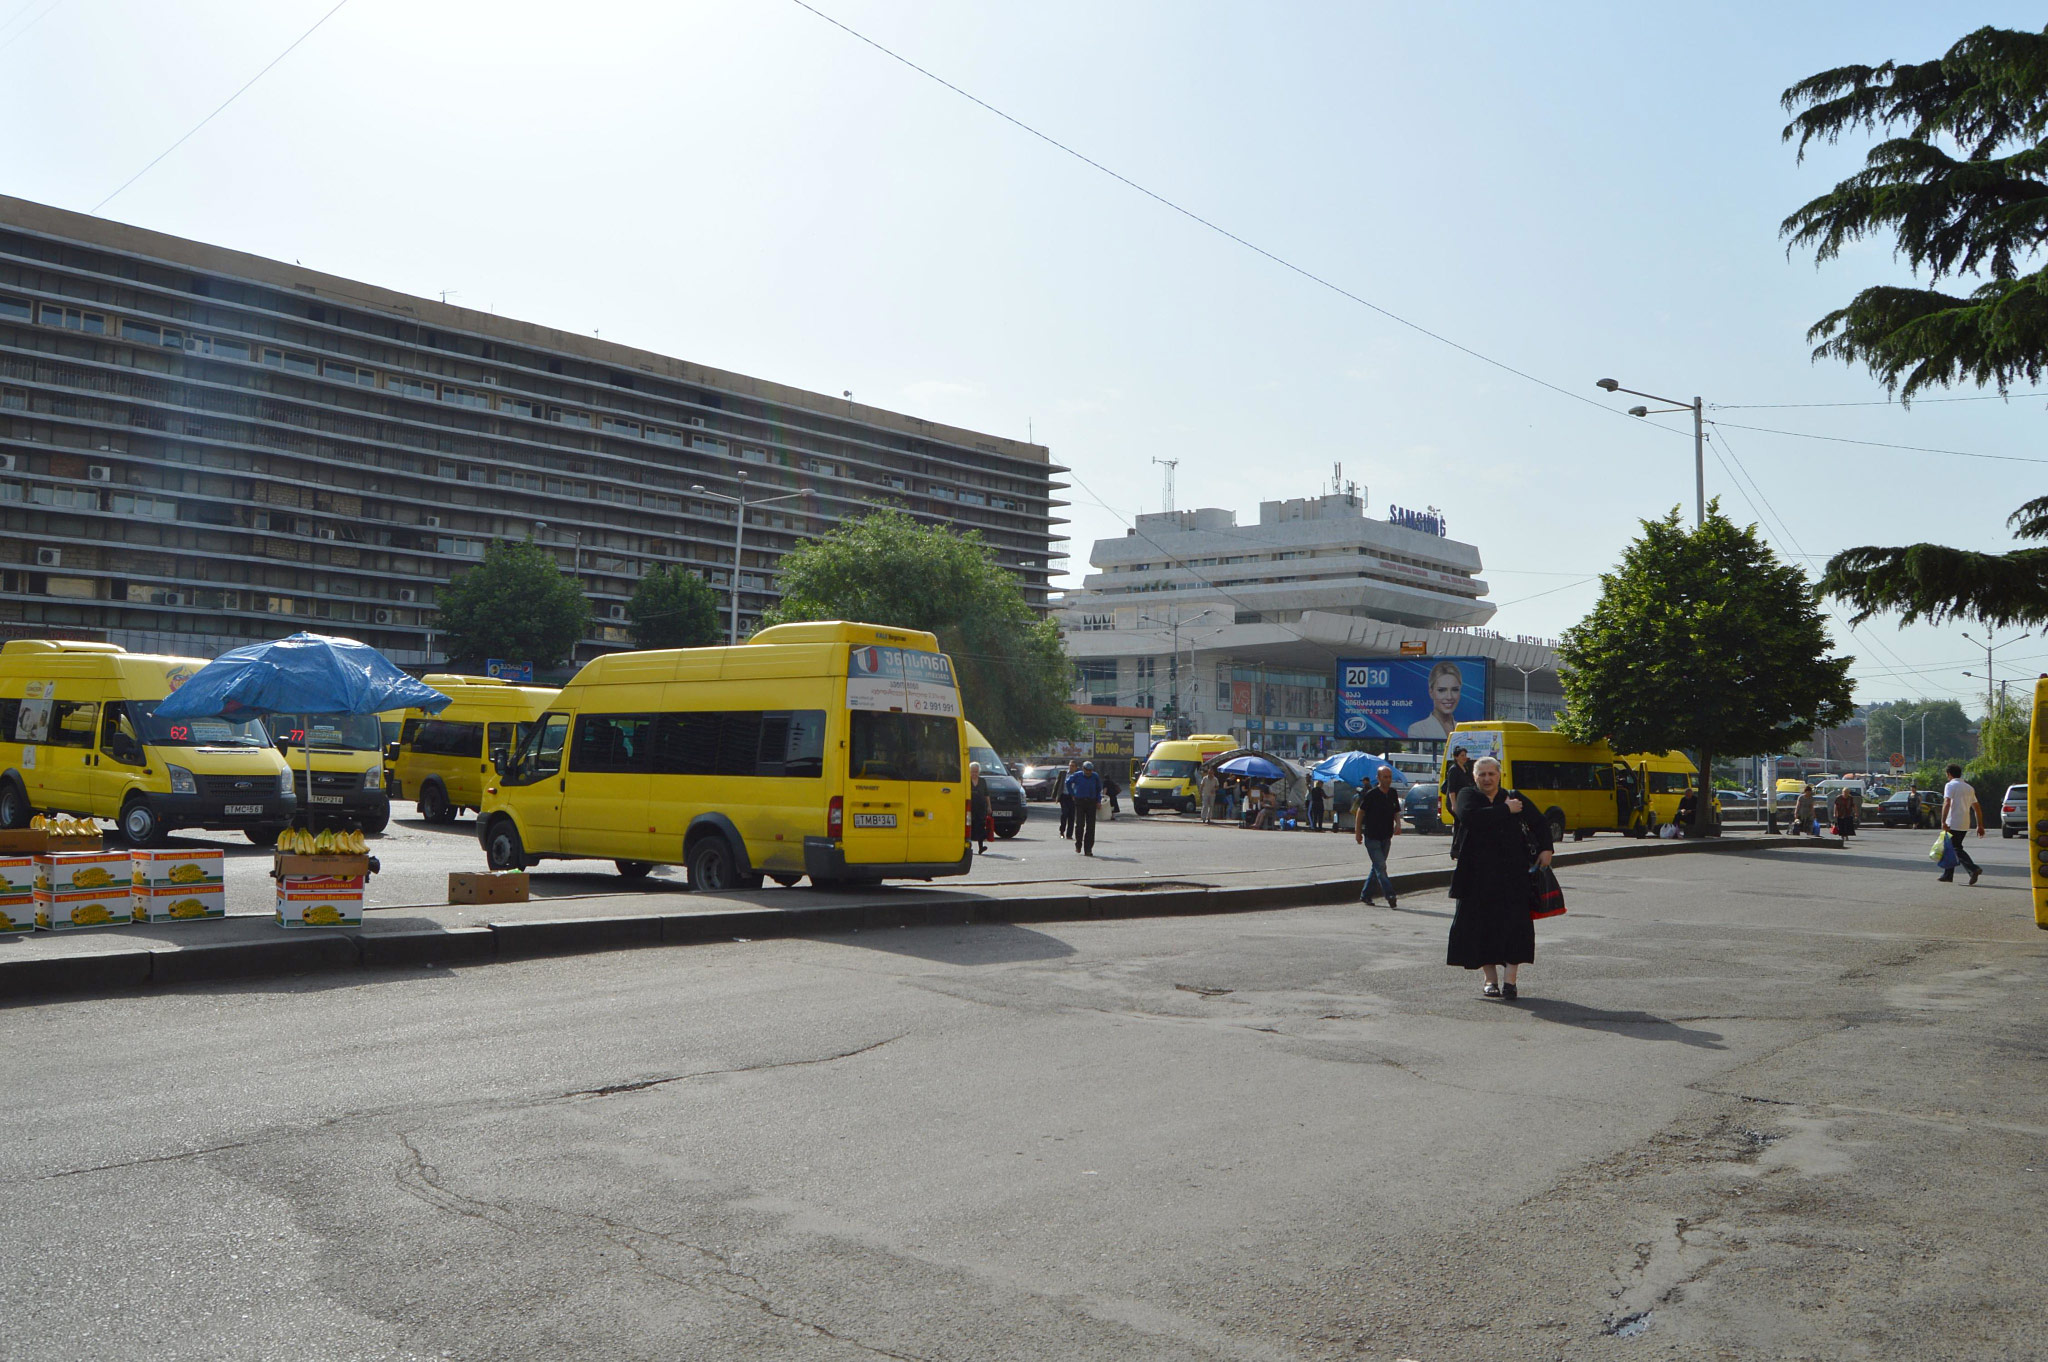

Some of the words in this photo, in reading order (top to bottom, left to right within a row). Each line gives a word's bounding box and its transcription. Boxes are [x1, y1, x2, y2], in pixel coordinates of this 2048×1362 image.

[1389, 503, 1446, 538] SAMSUNG
[884, 651, 949, 672] უნისონი
[923, 702, 928, 710] 2
[170, 726, 188, 740] 62
[290, 730, 304, 741] 77
[61, 857, 95, 865] Premium
[96, 854, 126, 862] Bananas
[60, 894, 94, 902] Premium
[95, 891, 126, 899] Bananas
[159, 888, 190, 896] Premium
